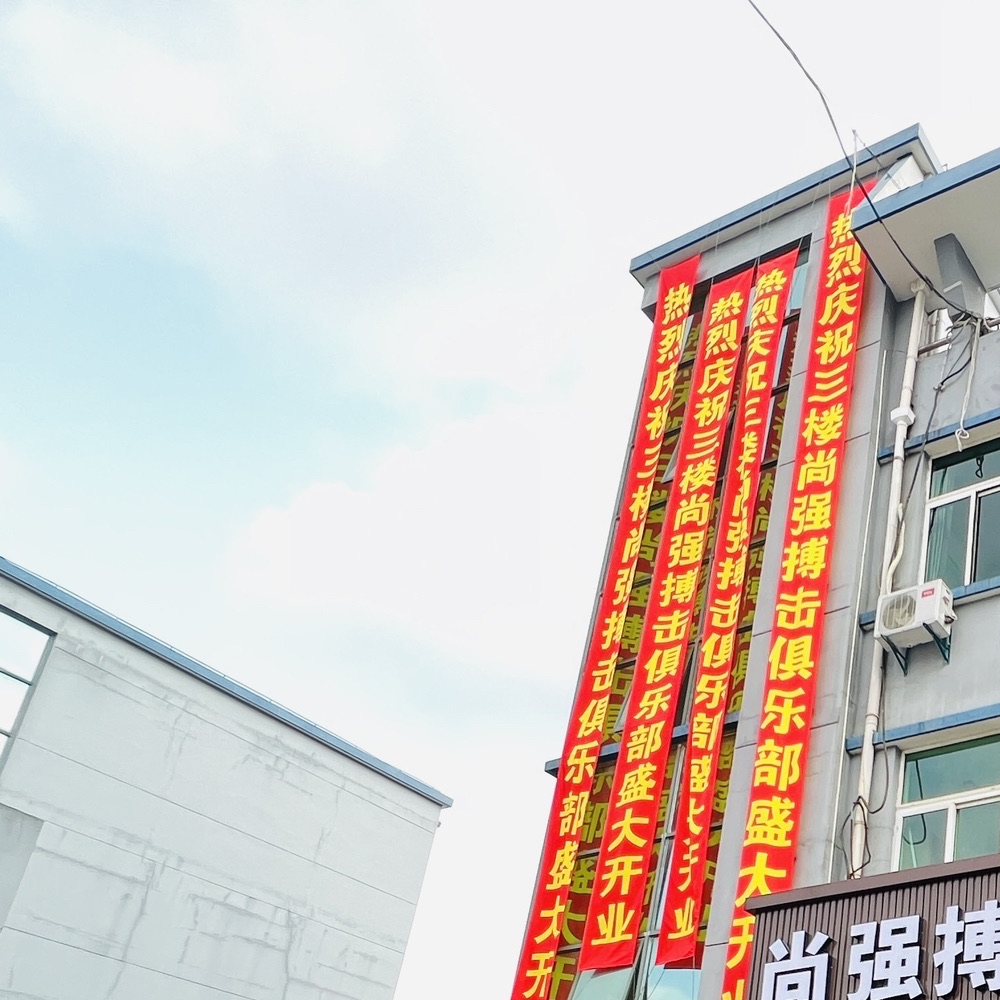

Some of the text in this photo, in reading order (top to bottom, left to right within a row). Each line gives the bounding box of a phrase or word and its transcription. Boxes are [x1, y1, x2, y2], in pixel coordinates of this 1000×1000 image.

[591, 290, 744, 945] 热烈庆祝三楼尚强搏击俱乐部盛大开业
